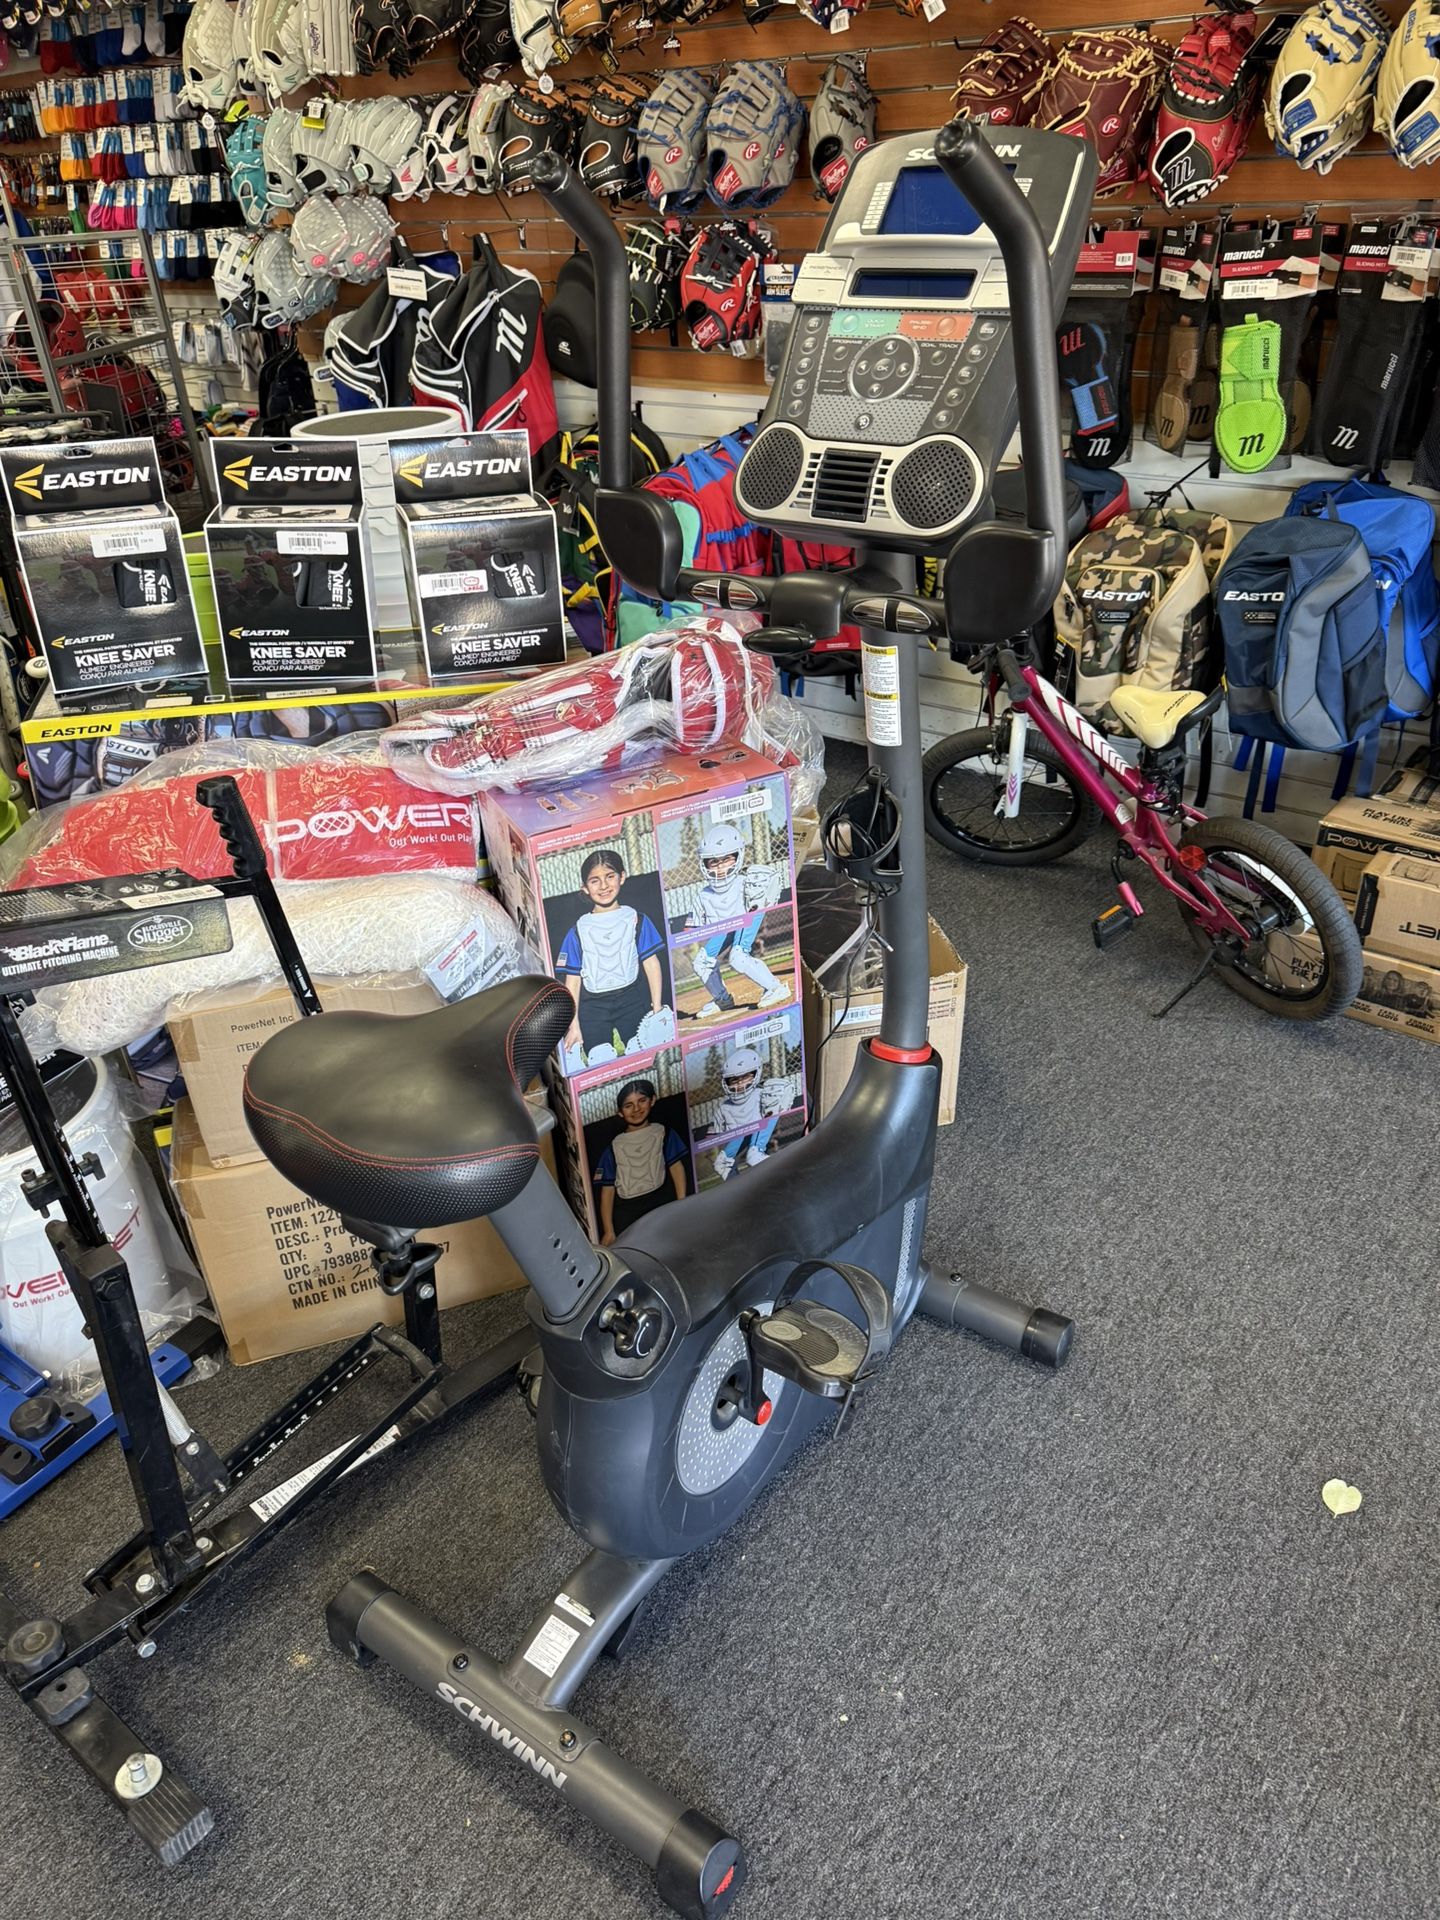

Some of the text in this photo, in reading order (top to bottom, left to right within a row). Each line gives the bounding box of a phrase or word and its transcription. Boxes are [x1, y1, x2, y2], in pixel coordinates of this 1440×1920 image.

[1162, 245, 1187, 257] marucci
[1223, 247, 1265, 262] marucci
[1349, 244, 1391, 255] marucci
[1262, 337, 1270, 370] marucci
[1379, 352, 1399, 390] marucci
[249, 465, 352, 482] EASTON
[424, 457, 521, 479] EASTON
[43, 466, 150, 491] EASTON
[143, 569, 157, 602] KNEE
[332, 572, 344, 603] KNEE
[509, 563, 527, 596] KNEE
[1082, 589, 1151, 602] EASTON
[241, 629, 290, 637] EASTON
[442, 622, 489, 633] EASTON
[64, 633, 115, 646] EASTON
[451, 635, 541, 655] KNEE SAVER
[74, 645, 176, 667] KNEE SAVER
[249, 646, 347, 659] KNEE SAVER
[480, 648, 521, 658] ENGINEERED
[107, 669, 123, 677] PAR
[109, 659, 155, 671] ENGINEERED
[41, 723, 113, 739] EASTON
[106, 740, 150, 757] STON
[1361, 811, 1380, 820] THE
[1363, 807, 1413, 823] PLAY LIKE
[389, 836, 407, 848] Out
[410, 834, 438, 846] Work!
[440, 833, 456, 843] Out
[146, 919, 182, 932] LOUISVILLE
[134, 924, 189, 945] Slugger
[1, 945, 120, 977] ULTIMATE PITCHING MACHINE
[1377, 1011, 1399, 1022] LLOYD
[230, 1017, 276, 1033] PowerNet
[271, 1216, 309, 1235] ITEM:
[275, 1232, 320, 1251] DESC.:
[279, 1241, 333, 1266] QTY: 3
[288, 1272, 345, 1296] CTN NO.:
[291, 1275, 382, 1311] MADE IN CHIN
[12, 1300, 28, 1309] Out
[30, 1294, 56, 1306] Work!
[435, 1681, 570, 1790] SCHWINN
